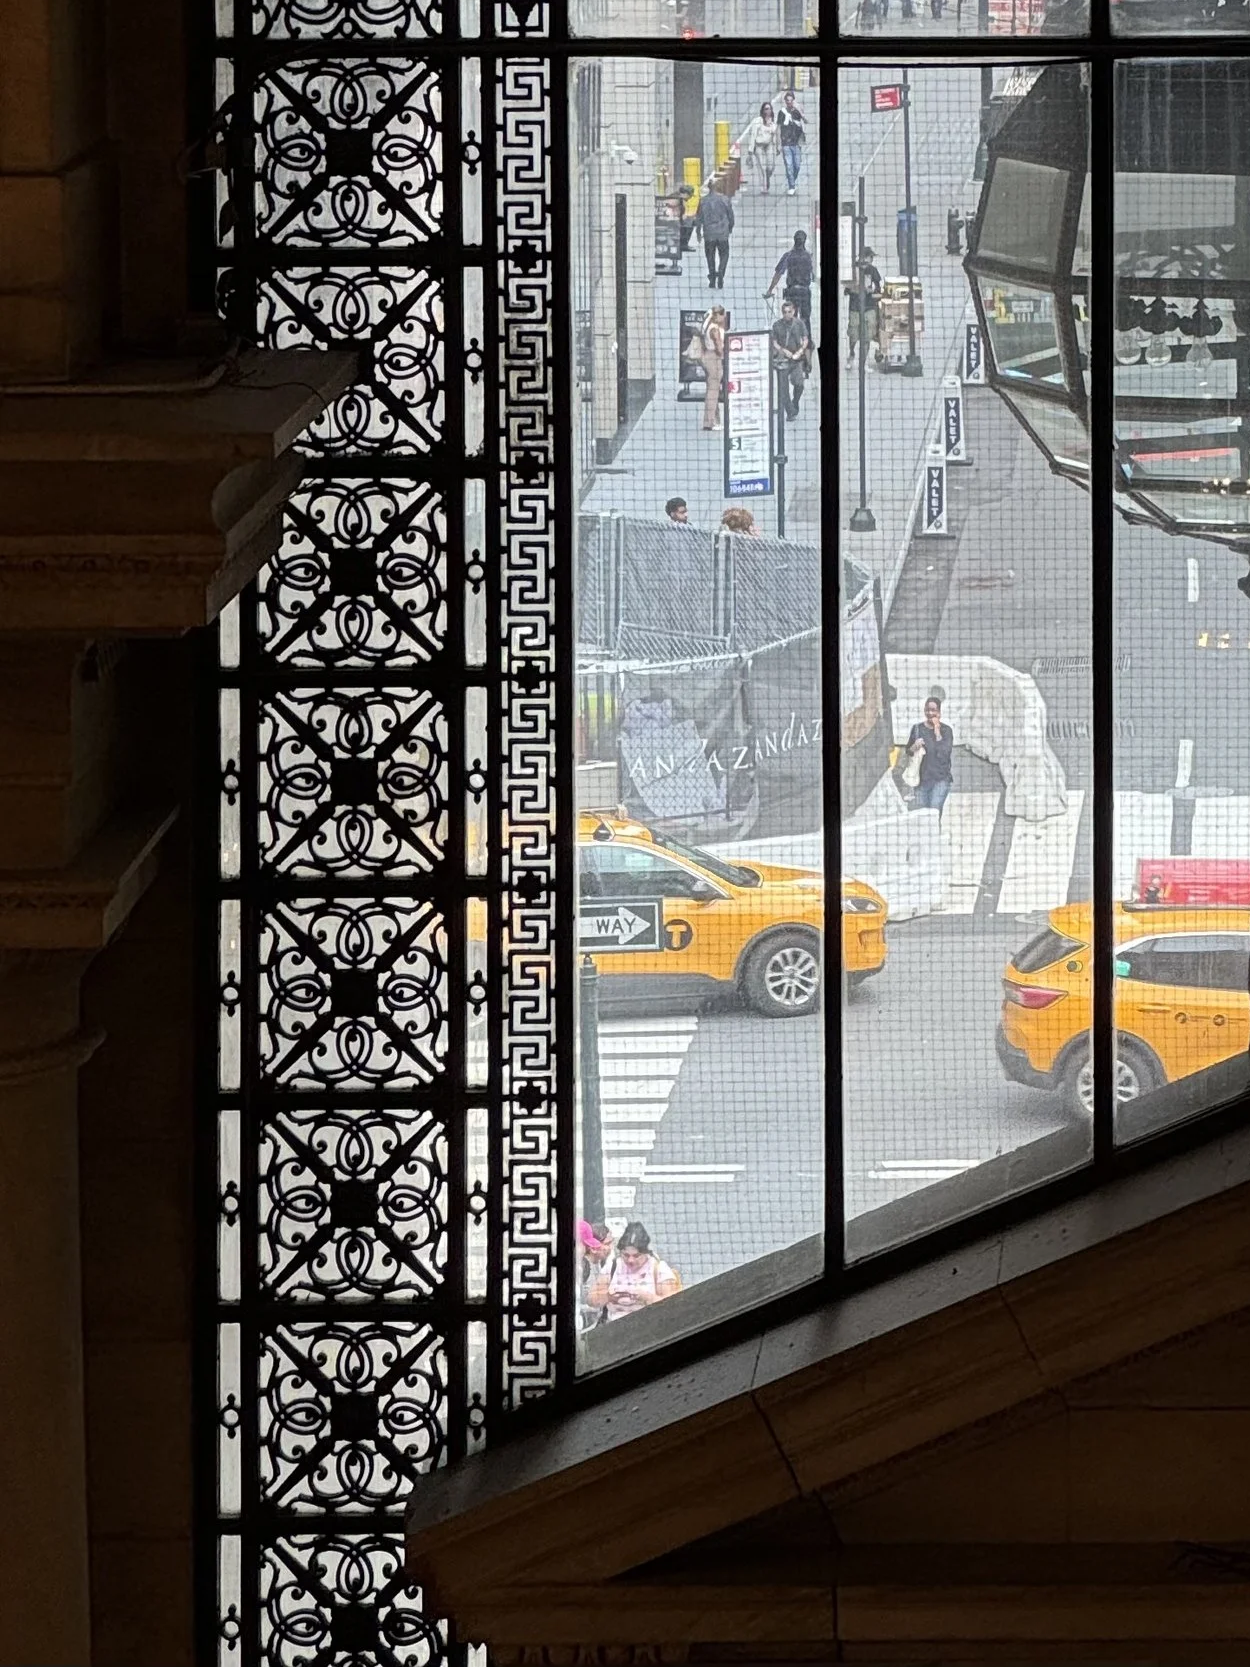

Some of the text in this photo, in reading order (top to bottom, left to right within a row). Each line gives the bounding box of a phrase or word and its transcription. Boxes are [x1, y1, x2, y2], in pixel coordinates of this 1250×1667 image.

[970, 326, 978, 368] VALET
[948, 400, 957, 444] VALET
[931, 469, 941, 516] VALET
[596, 917, 636, 934] WAY
[665, 924, 688, 948] T
